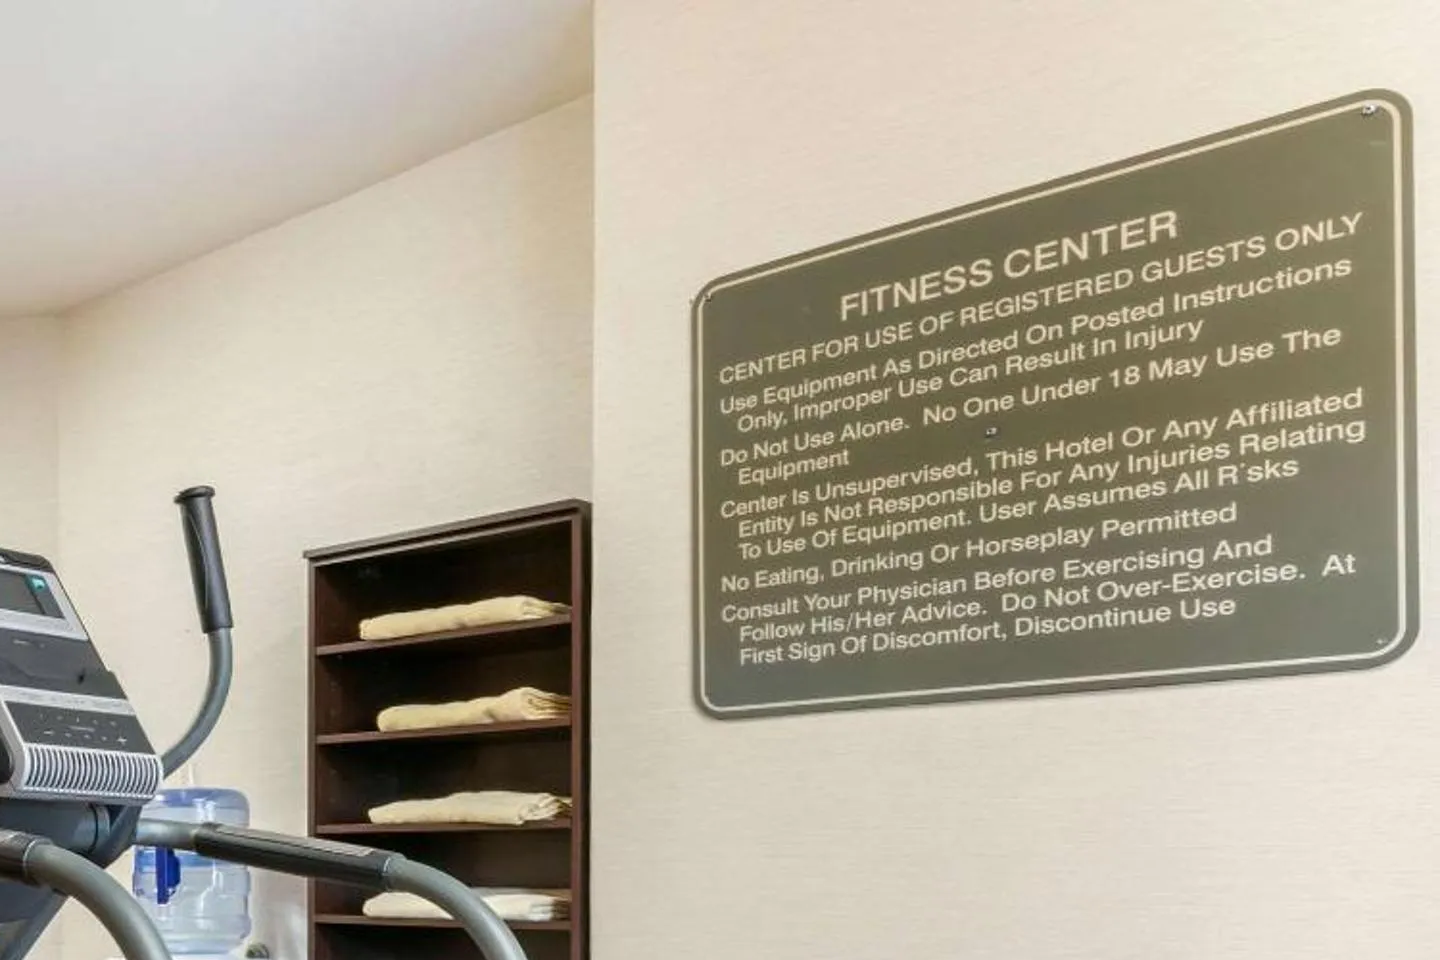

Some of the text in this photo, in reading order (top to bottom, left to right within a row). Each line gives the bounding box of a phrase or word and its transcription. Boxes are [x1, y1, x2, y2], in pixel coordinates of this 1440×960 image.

[719, 211, 1363, 385] CENTER FOR USE OF REGISTERED GUESTS ONLY
[840, 210, 1178, 322] FITNESS CENTER
[720, 259, 1352, 415] Use Equipment As Directed On Posted Instructions
[793, 387, 893, 421] Improper
[898, 376, 943, 398] Use
[949, 364, 998, 387] Can
[1005, 341, 1086, 376] Result
[1092, 337, 1117, 357] In
[1125, 319, 1204, 351] Injury
[720, 328, 1342, 467] Do Not Use Alone. No One Under 18 May Use The
[720, 494, 787, 519] Center
[792, 488, 810, 505] Is
[984, 447, 1038, 471] This
[1045, 431, 1114, 462] Hotel
[1121, 426, 1157, 448] Or
[1162, 416, 1219, 442] Any
[1225, 386, 1363, 431] Affiliated
[738, 448, 850, 486] Equipment
[738, 420, 1366, 538] Entity Is Not Responsible For Any Injuries Relating
[721, 574, 750, 593] No
[831, 551, 924, 577] Drinking
[930, 543, 960, 564] Or
[966, 526, 1095, 559] Horseplay
[1101, 501, 1237, 539] Permitted
[738, 542, 762, 560] To
[767, 537, 807, 556] Use
[811, 528, 838, 549] Of
[842, 509, 972, 545] Equipment.
[979, 500, 1037, 523] User
[1043, 480, 1168, 514] Assumes
[1173, 468, 1209, 494] All
[721, 533, 1272, 623] Consult Your Physician Before Exercising And
[739, 553, 1357, 643] Follow His/Her Advice. Do Not Over-Exercise. At
[739, 598, 1237, 666] First Sign Of Discomfort, Discontinue Use
